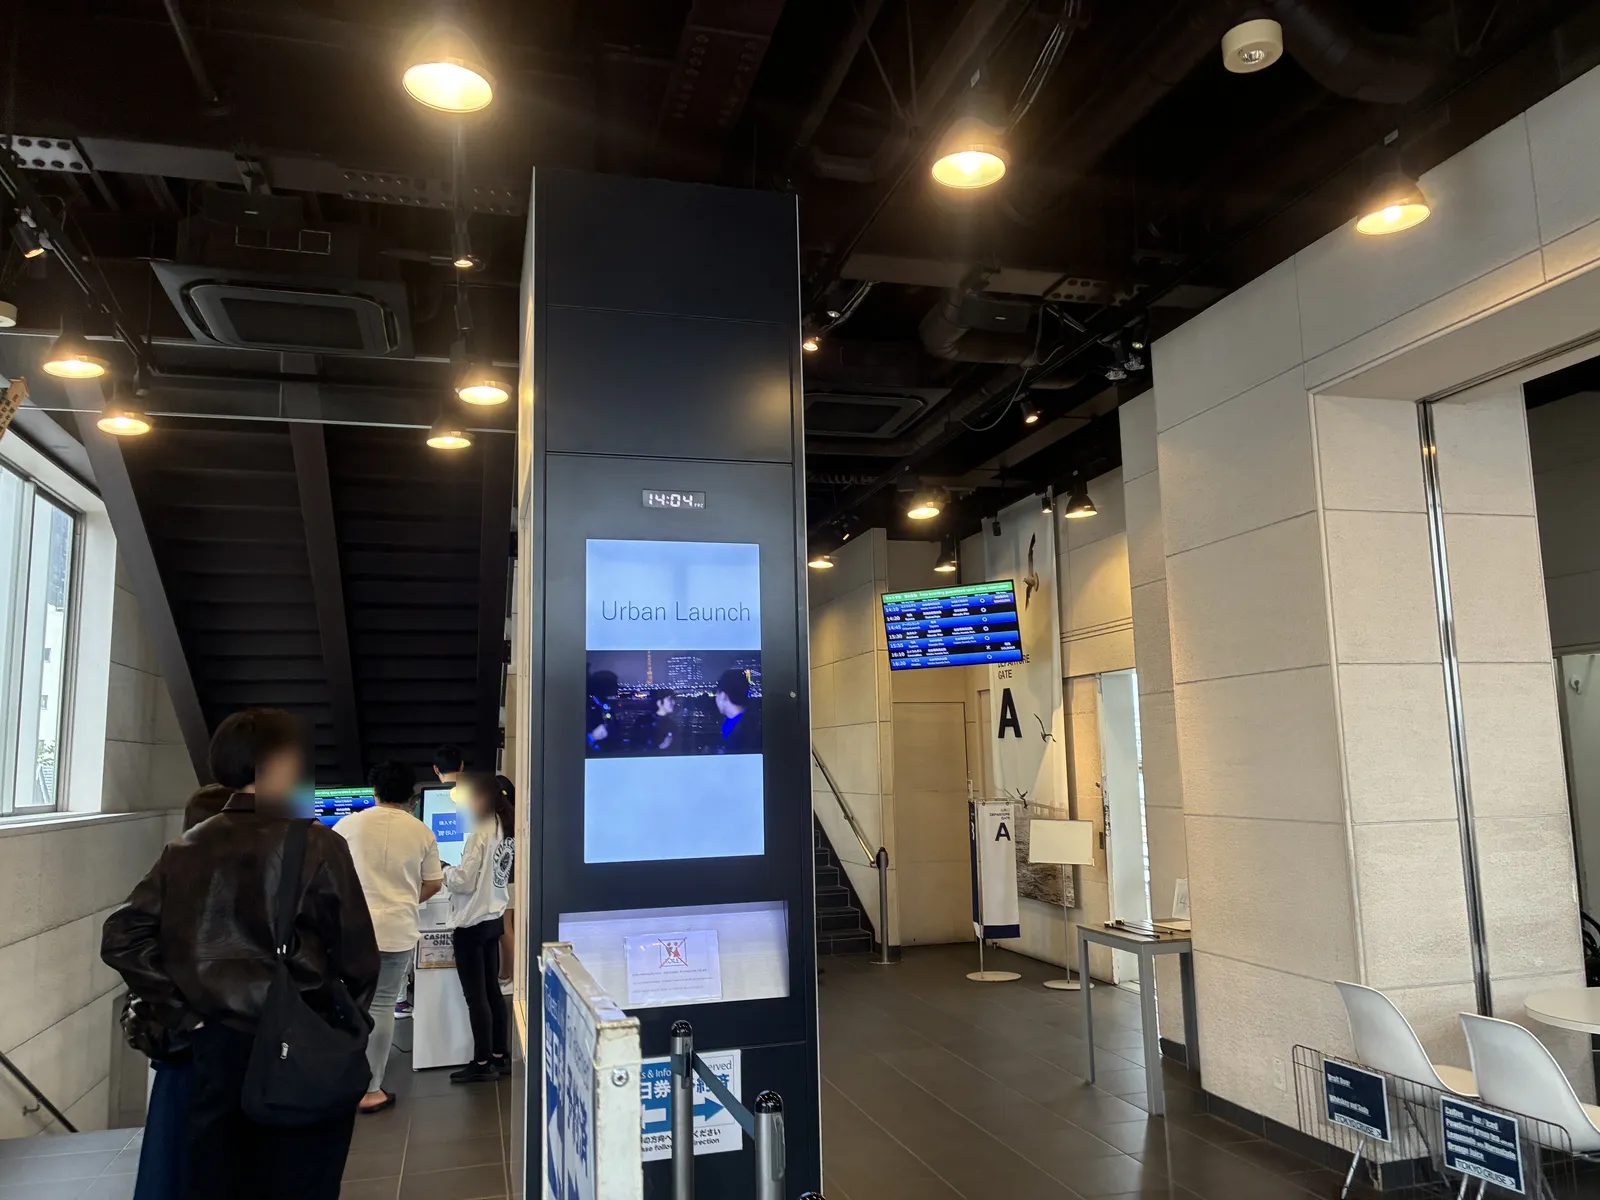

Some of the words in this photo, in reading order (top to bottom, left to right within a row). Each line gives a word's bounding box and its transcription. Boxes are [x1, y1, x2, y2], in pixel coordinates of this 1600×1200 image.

[649, 493, 693, 508] 14:04
[602, 600, 666, 621] Urban
[675, 601, 751, 622] Launch
[998, 669, 1012, 680] GATE
[998, 688, 1022, 739] A
[995, 822, 1011, 841] A
[656, 1068, 672, 1077] Info
[641, 1079, 671, 1099] 日券
[1457, 1161, 1482, 1175] TOKYO
[1482, 1168, 1507, 1185] CRUISE
